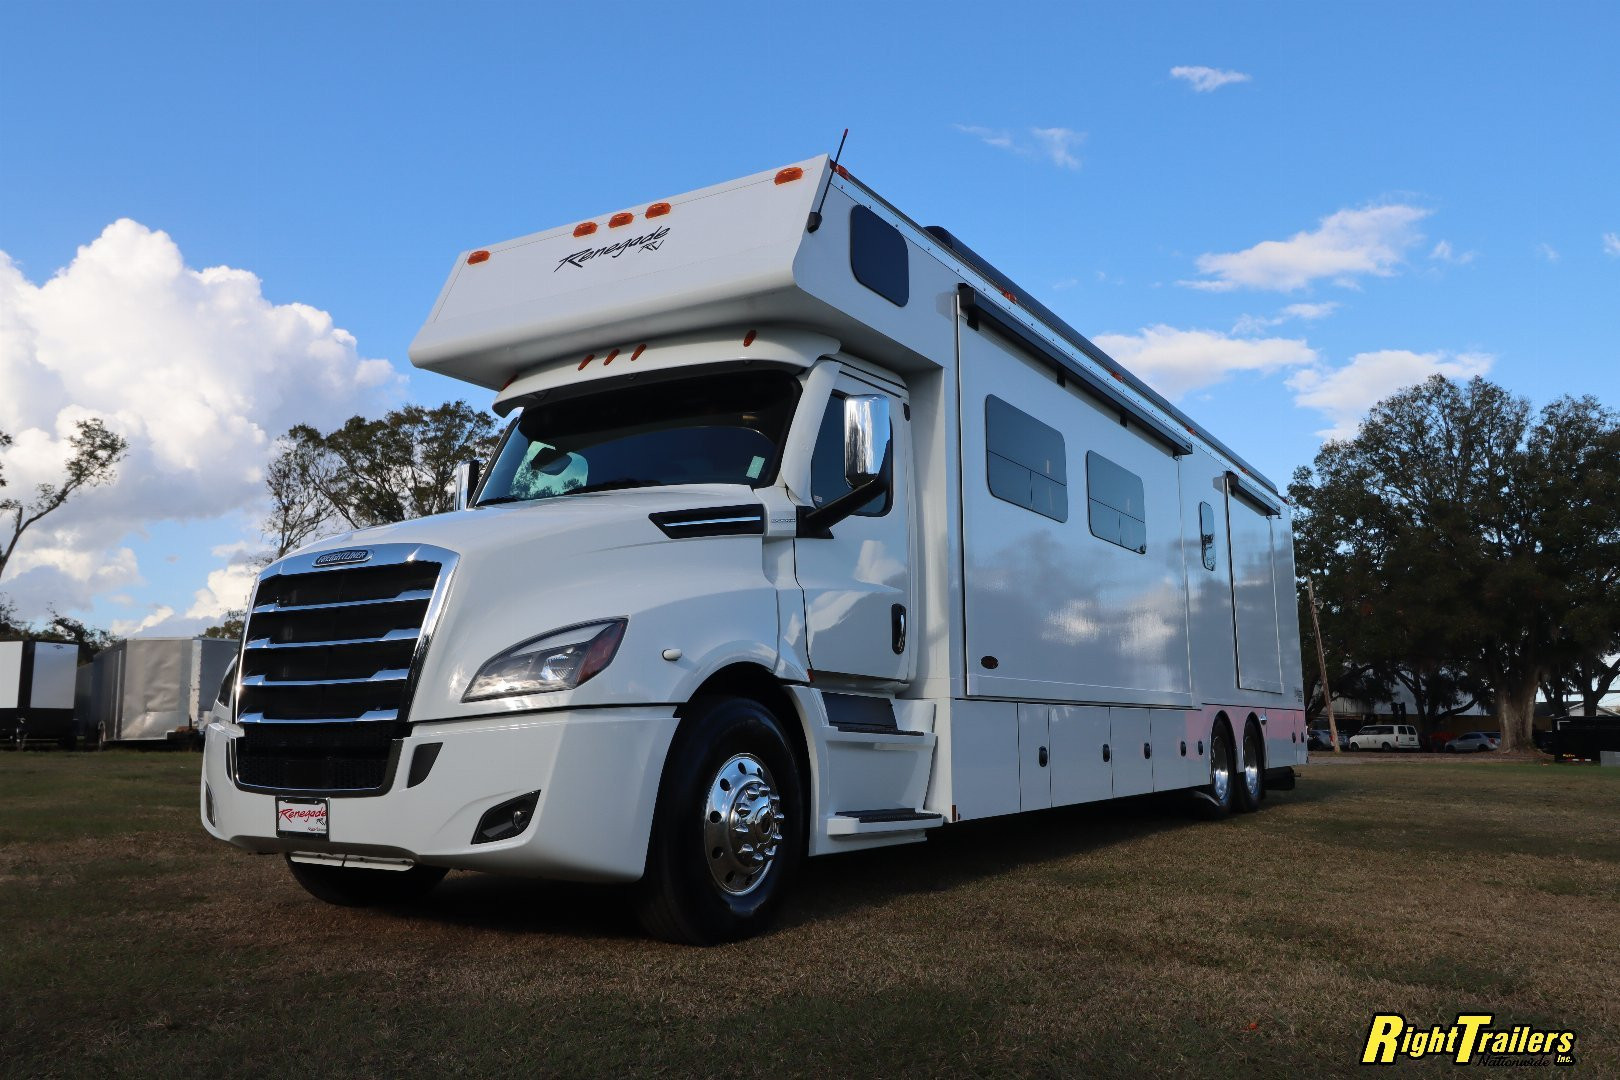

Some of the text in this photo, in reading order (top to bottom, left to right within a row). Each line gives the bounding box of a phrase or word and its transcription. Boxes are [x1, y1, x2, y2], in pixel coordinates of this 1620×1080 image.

[554, 226, 671, 272] Renegade
[638, 240, 665, 253] RV
[317, 551, 366, 564] FREIGHTLINER
[278, 807, 328, 823] Renegade
